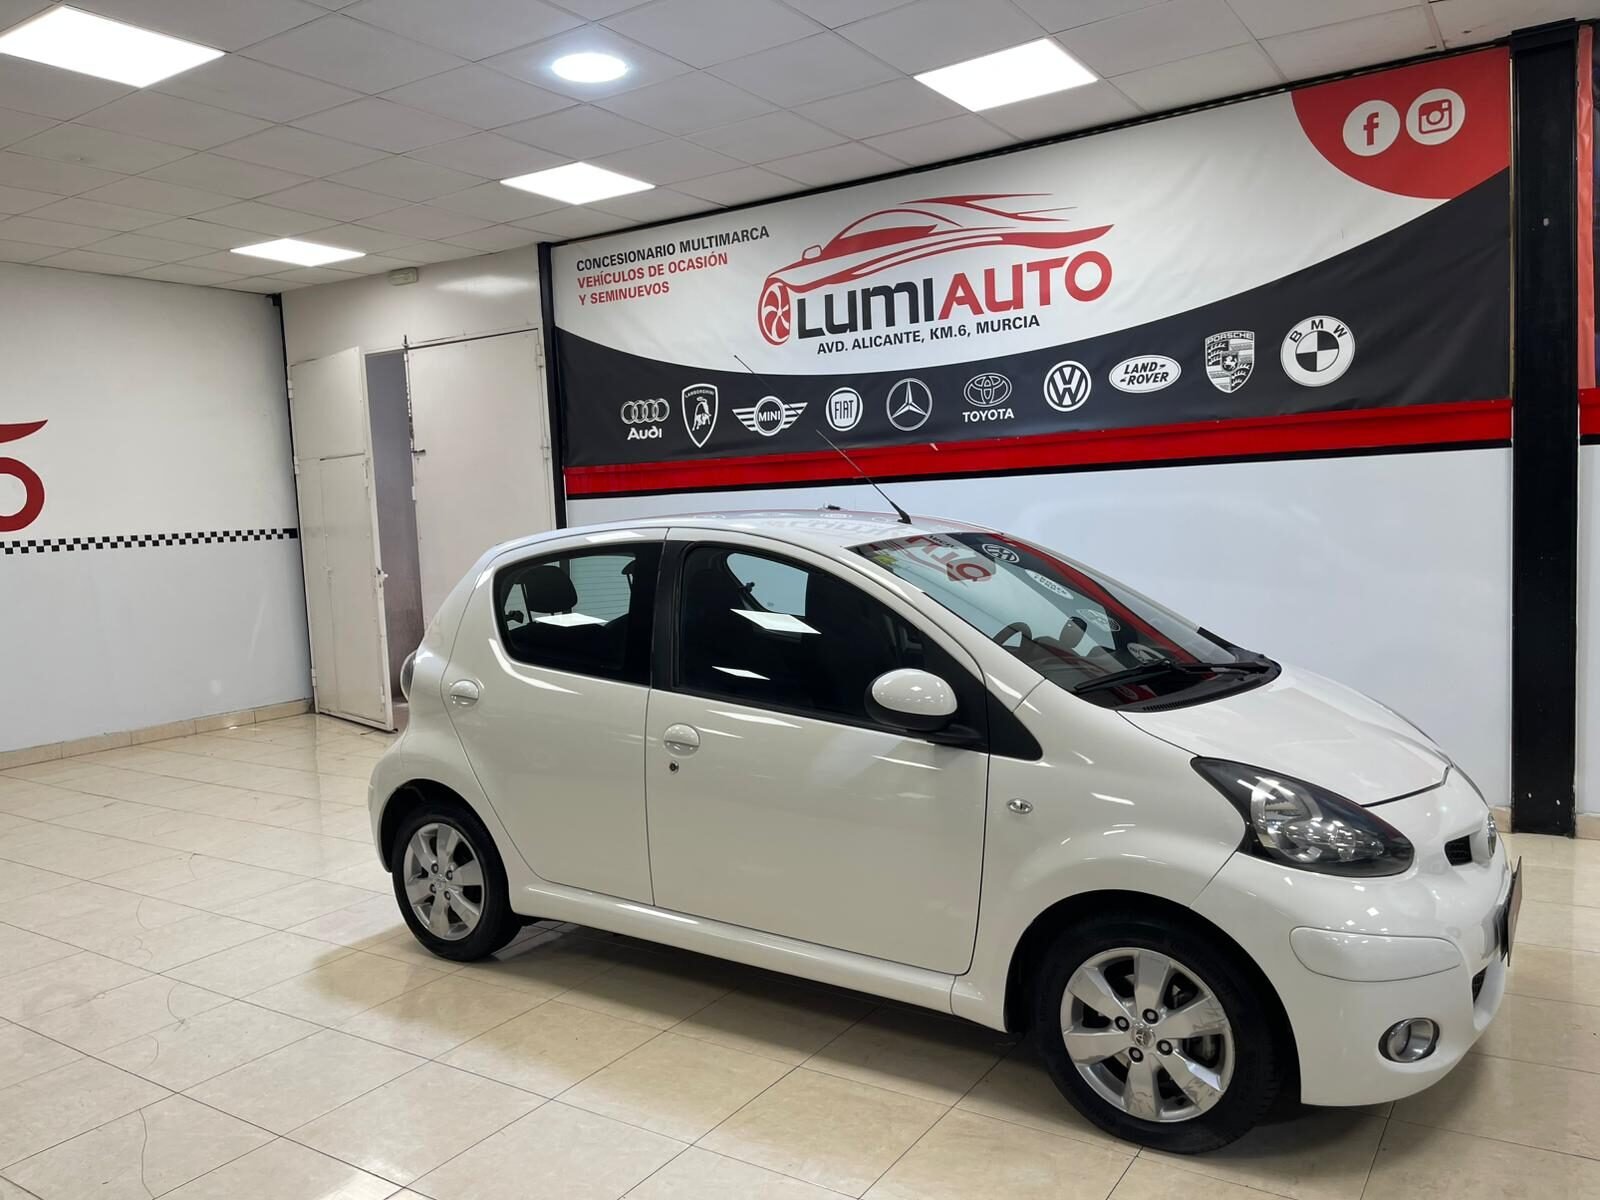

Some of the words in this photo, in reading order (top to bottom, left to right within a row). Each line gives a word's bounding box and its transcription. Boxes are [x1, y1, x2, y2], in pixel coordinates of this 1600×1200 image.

[576, 243, 676, 272] CONCESIONARIO
[679, 225, 770, 253] MULTIMARCA
[577, 267, 645, 289] VEHÍCULOS
[648, 263, 665, 278] DE
[668, 251, 728, 274] OCASIÓN
[579, 294, 587, 306] Y
[590, 281, 670, 305] SEMINUEVOS
[816, 341, 849, 355] AVD.
[851, 329, 926, 351] ALICANTE,
[929, 323, 972, 342] KM.6,
[975, 314, 1041, 335] MURCIA
[1206, 331, 1254, 344] PORSCHE
[1288, 319, 1348, 344] BMW
[1123, 362, 1157, 375] LAND
[1127, 371, 1169, 385] ROVER
[758, 411, 782, 423] MINI
[834, 400, 855, 421] FIAT
[962, 407, 1015, 422] TOYOTA
[627, 426, 663, 441] Audi
